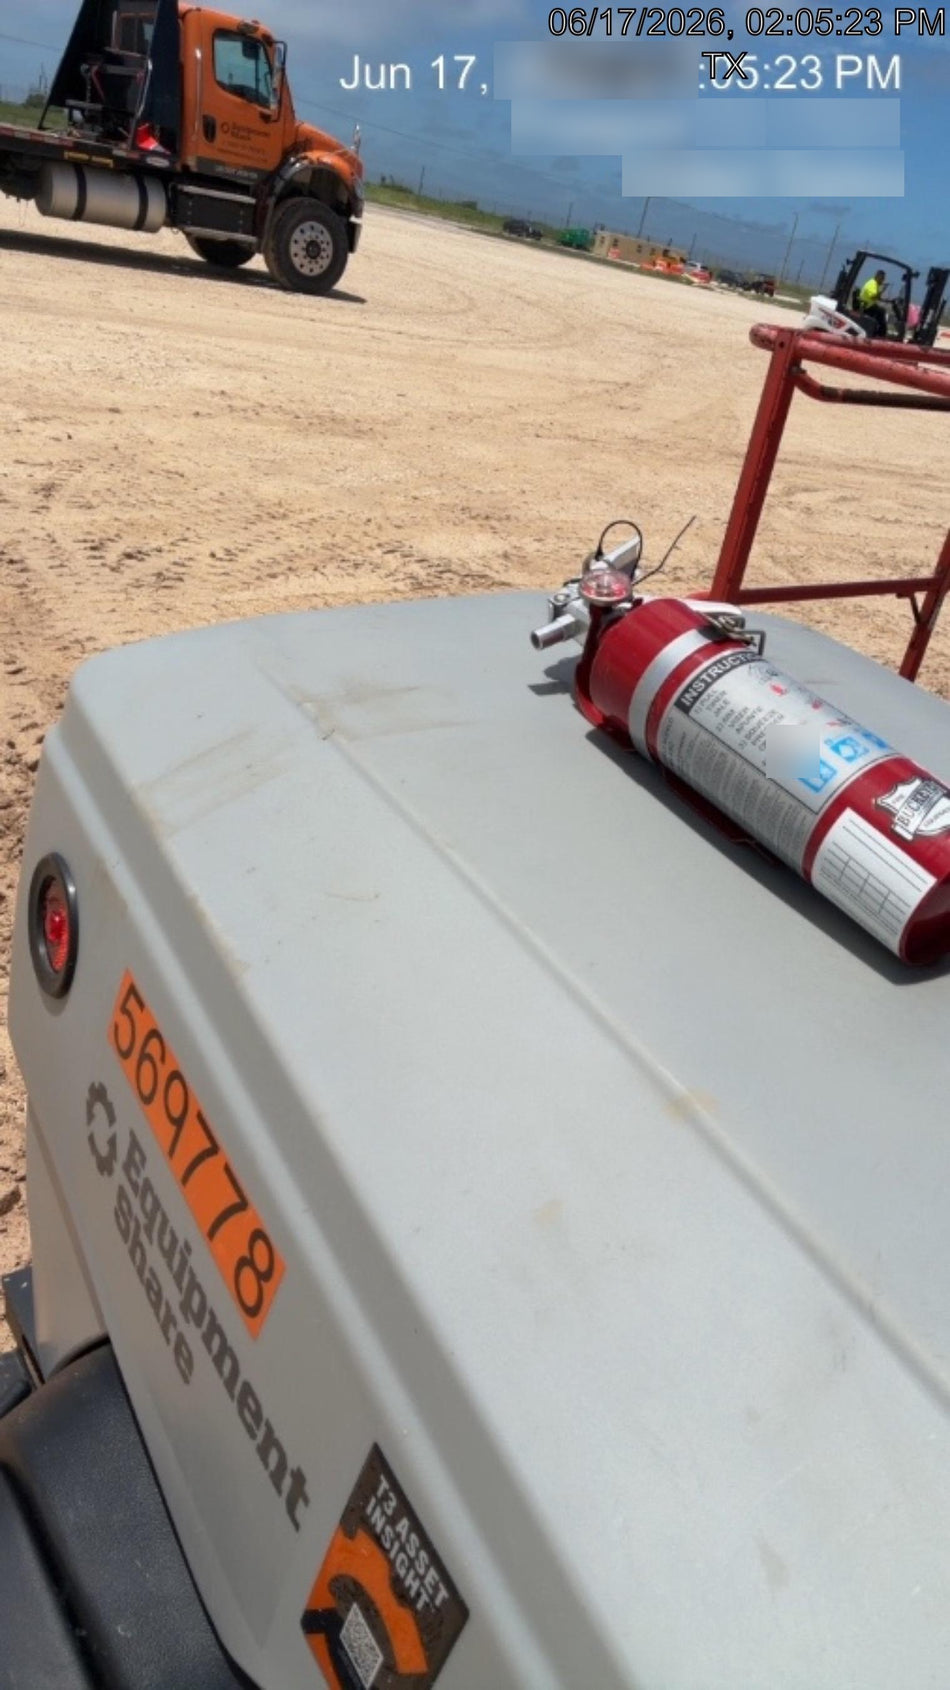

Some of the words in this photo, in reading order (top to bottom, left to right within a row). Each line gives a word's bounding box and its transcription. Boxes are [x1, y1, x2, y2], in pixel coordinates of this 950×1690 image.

[113, 982, 275, 1320] 569778
[113, 1183, 195, 1386] Share
[121, 1128, 310, 1533] Equipment
[365, 1496, 430, 1612] INSIGHT
[375, 1474, 398, 1516] T3
[395, 1517, 450, 1608] ASSET
